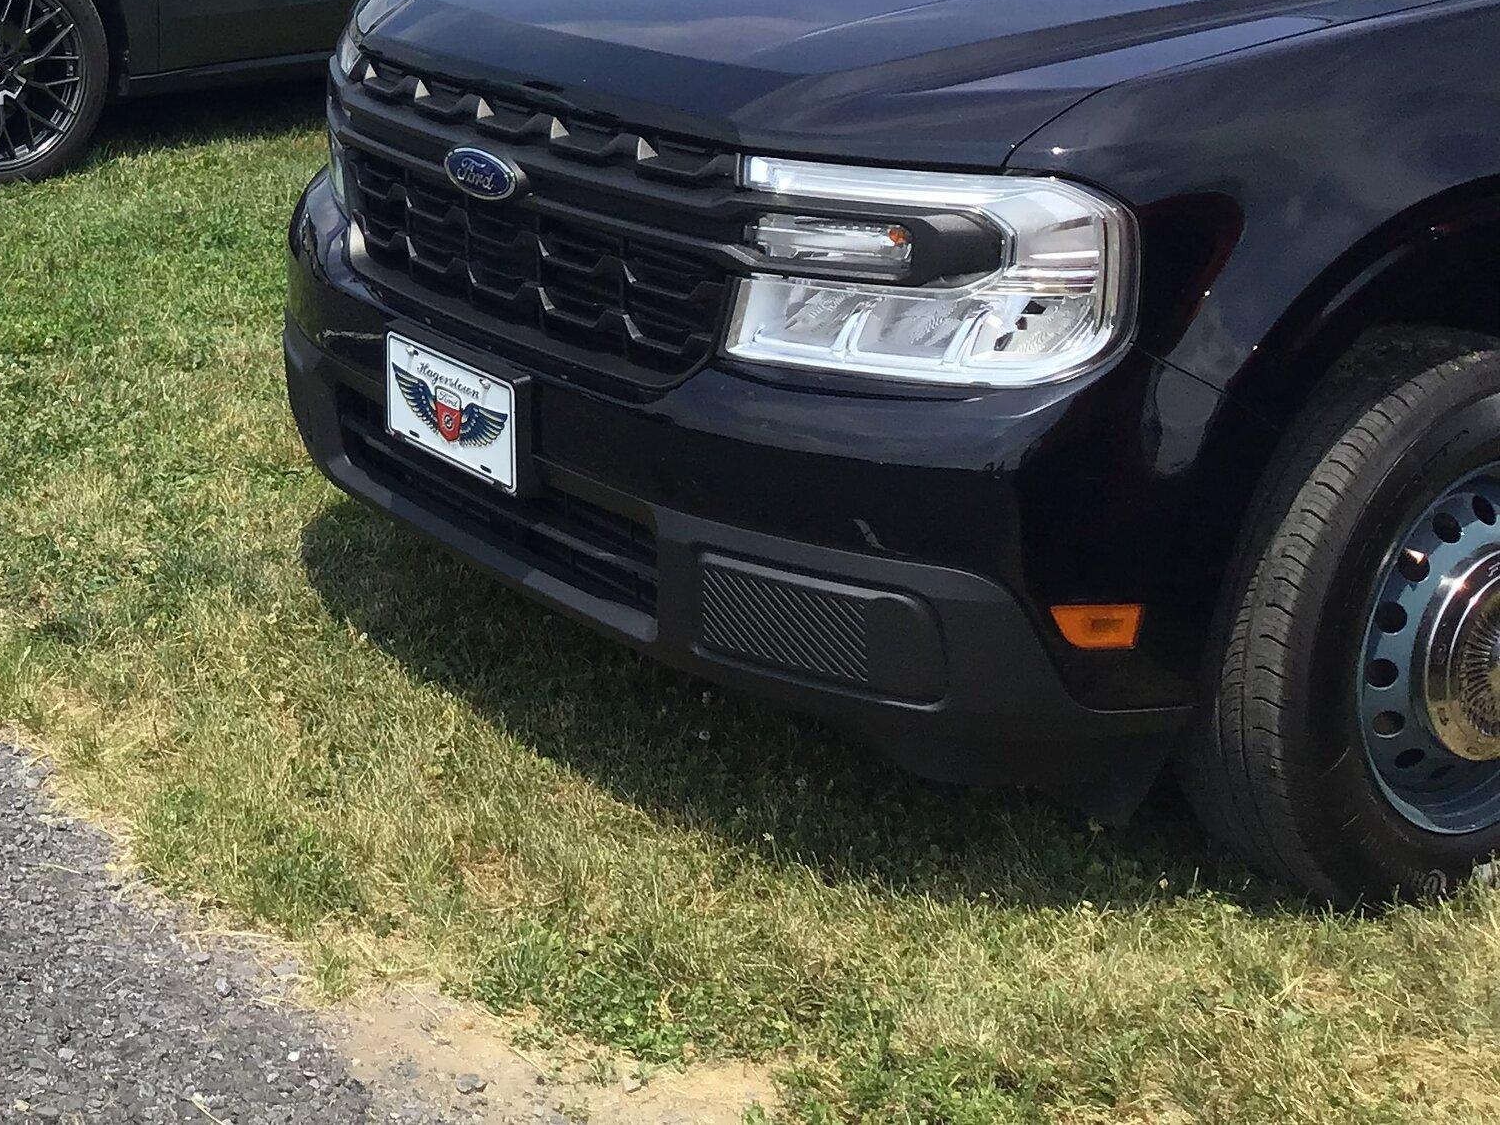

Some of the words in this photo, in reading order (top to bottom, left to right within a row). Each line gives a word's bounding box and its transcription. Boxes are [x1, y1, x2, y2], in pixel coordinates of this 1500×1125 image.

[456, 157, 496, 191] Ford
[417, 361, 480, 399] Hagerstown
[438, 390, 459, 408] Ford
